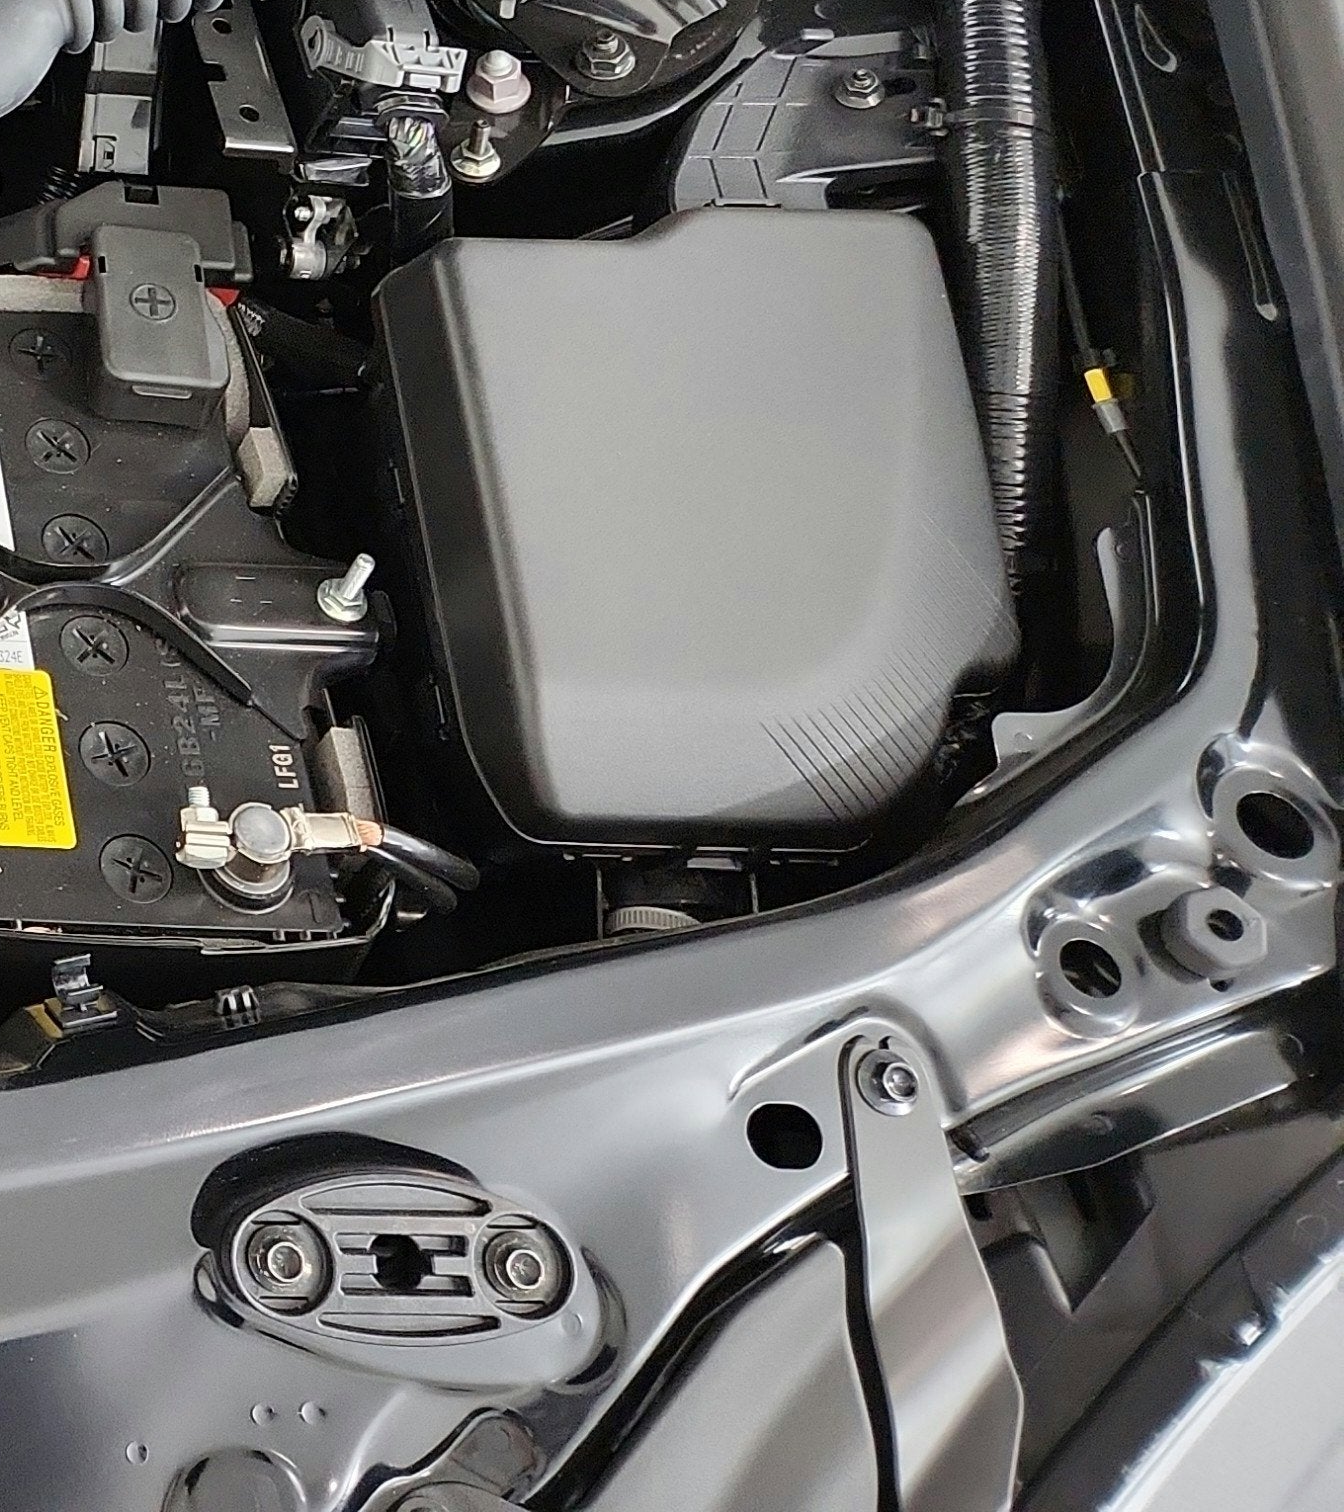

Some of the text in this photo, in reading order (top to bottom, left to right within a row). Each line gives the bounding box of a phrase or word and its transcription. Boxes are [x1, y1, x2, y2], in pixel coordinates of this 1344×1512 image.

[0, 714, 12, 733] VENT
[36, 702, 57, 752] DANGER
[2, 735, 15, 755] CAPS
[5, 756, 18, 778] TIGHT
[44, 755, 62, 798] EXPLOSIVE
[8, 780, 20, 796] AND
[10, 798, 25, 821] LEVEL
[51, 799, 66, 826] GASES
